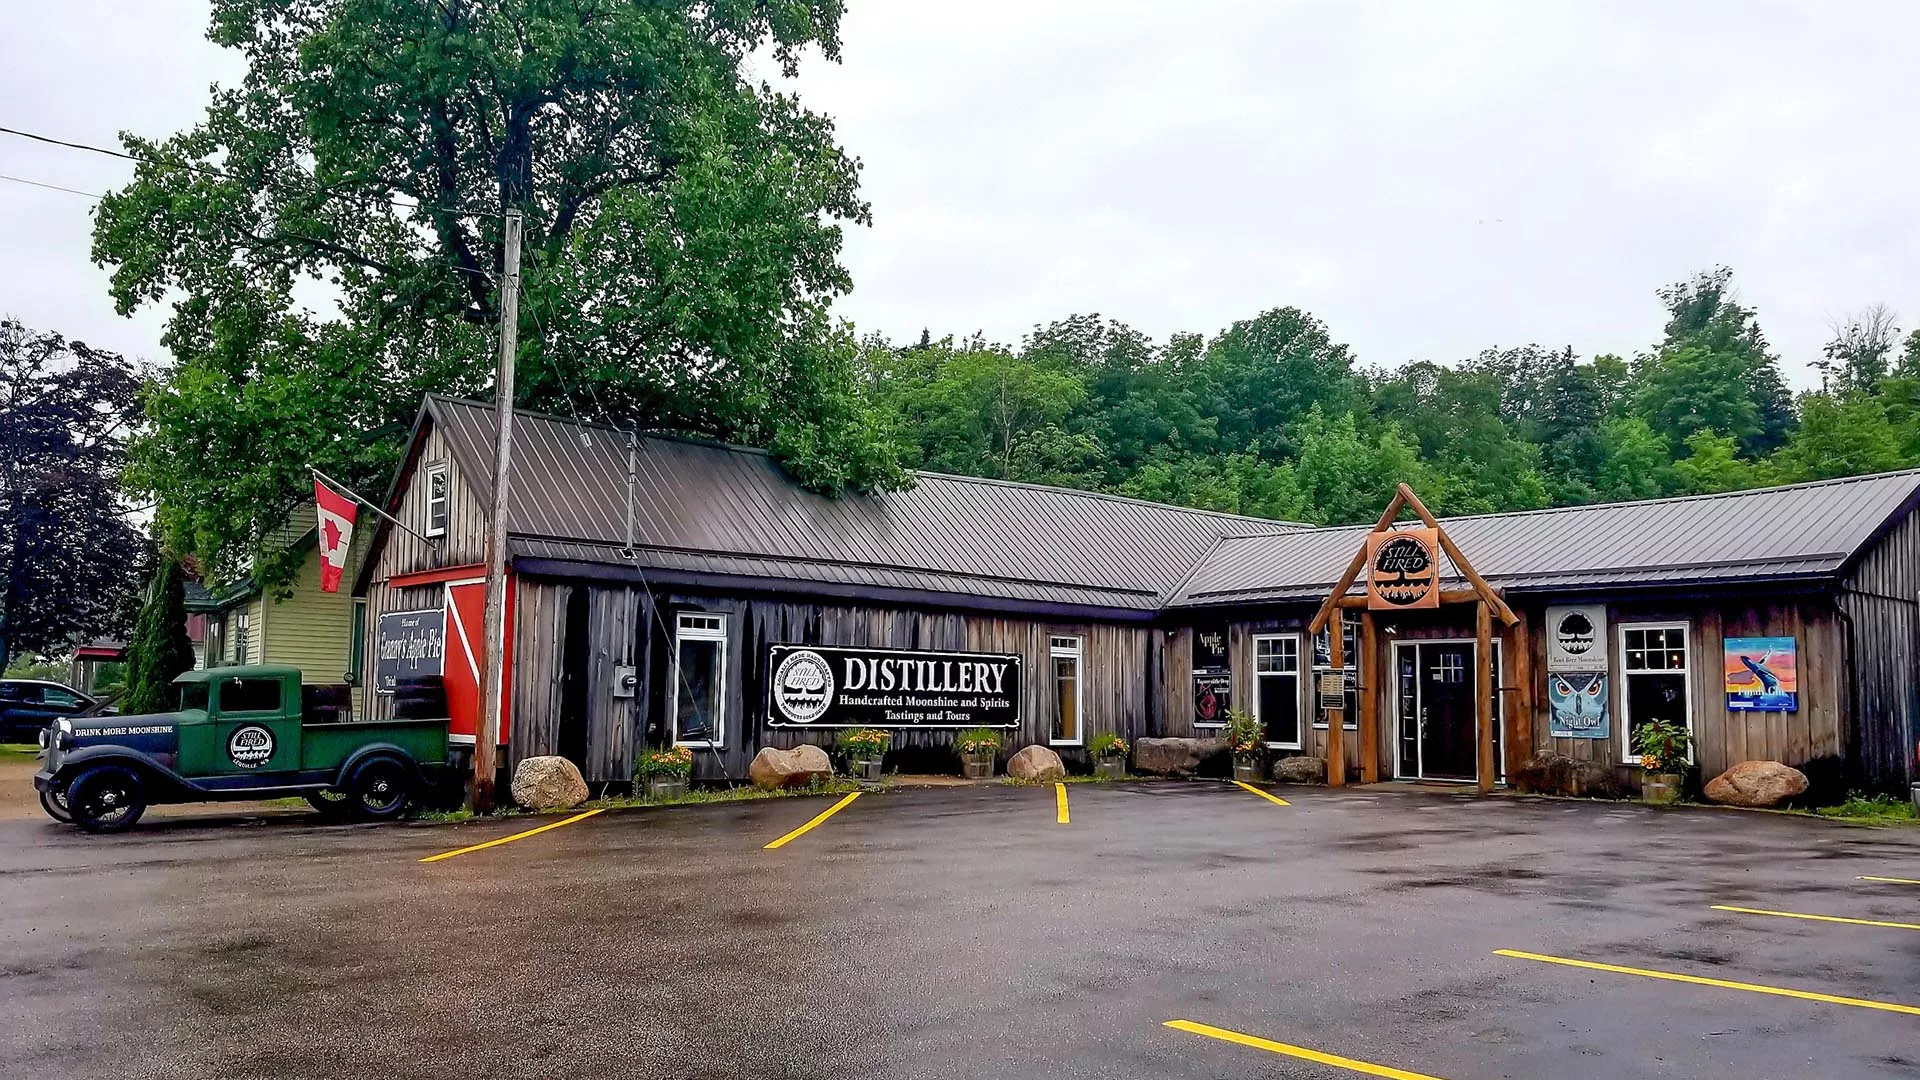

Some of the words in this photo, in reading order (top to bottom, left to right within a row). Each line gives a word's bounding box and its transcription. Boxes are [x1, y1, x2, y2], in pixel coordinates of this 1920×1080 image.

[1385, 545, 1420, 559] STILL
[1382, 557, 1424, 571] FIRED
[401, 618, 415, 627] Home
[415, 617, 421, 626] of
[1199, 632, 1222, 647] Apple
[381, 631, 407, 670] Granny's
[406, 630, 427, 669] Apple
[428, 628, 441, 658] Pie
[1211, 643, 1225, 654] Pie
[777, 660, 790, 686] LOCALLY
[790, 653, 805, 661] MADE
[792, 667, 818, 677] STILL
[843, 657, 1008, 693] DISTILLERY
[790, 677, 820, 688] FIRED
[839, 694, 903, 706] Handcrafted
[905, 696, 958, 707] Moonshine
[960, 697, 978, 707] and
[980, 697, 1010, 710] Spirits
[885, 710, 924, 723] Tastings
[926, 711, 943, 720] and
[945, 710, 971, 720] Tours
[1560, 716, 1582, 728] Night
[1583, 716, 1600, 726] Owl
[74, 729, 102, 737] DRINK
[102, 727, 127, 736] MORE
[128, 726, 173, 735] MOONSHINE
[241, 731, 262, 740] STILL
[240, 738, 265, 746] FIRED
